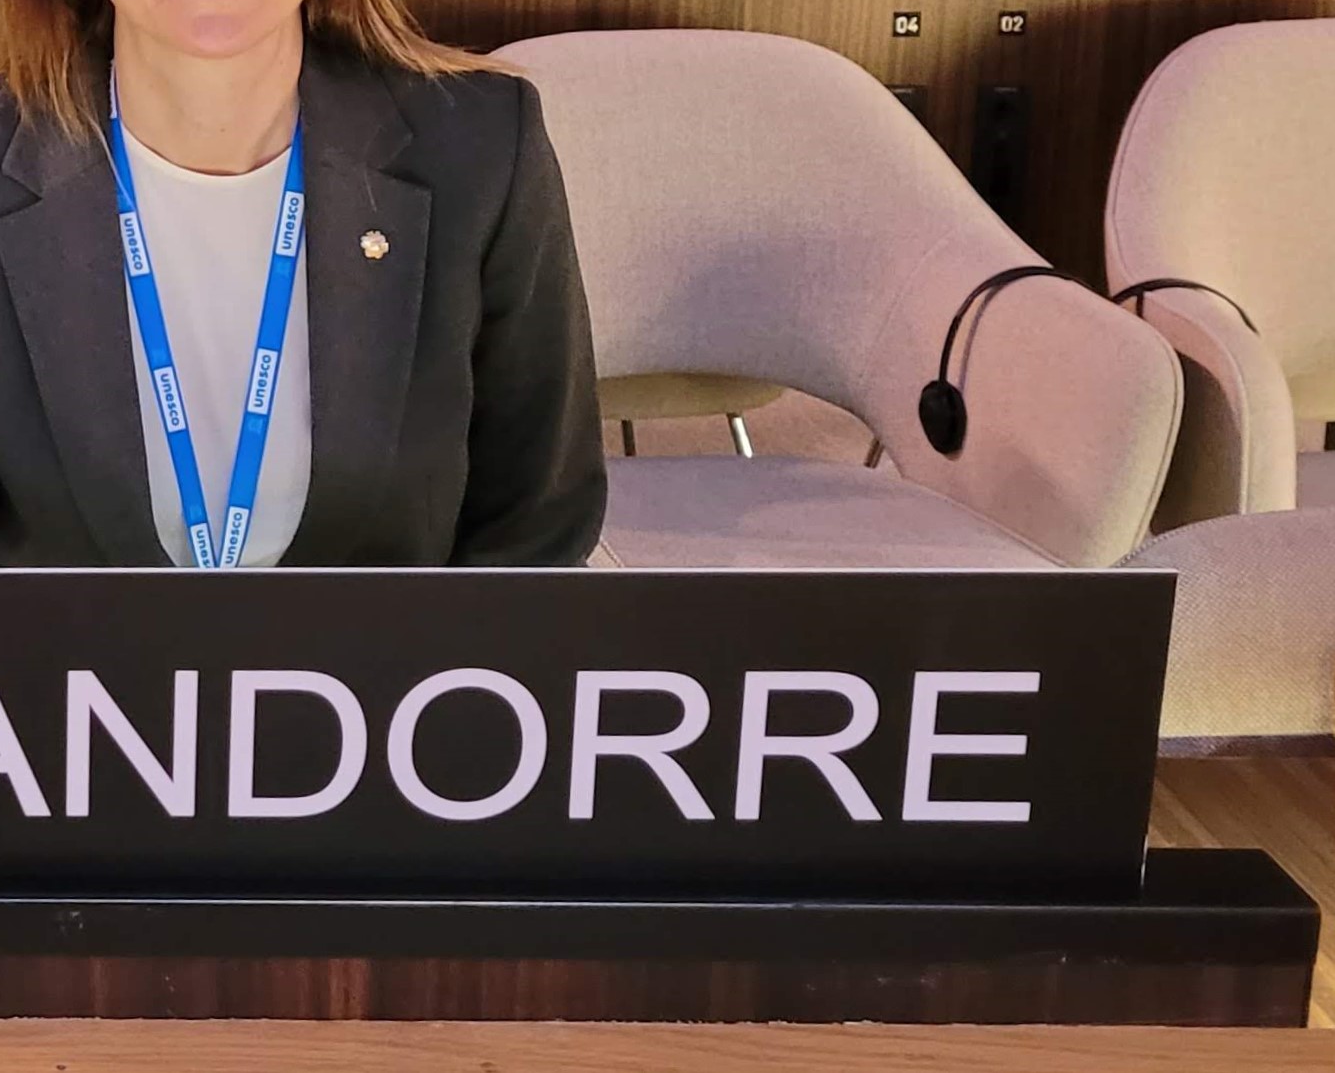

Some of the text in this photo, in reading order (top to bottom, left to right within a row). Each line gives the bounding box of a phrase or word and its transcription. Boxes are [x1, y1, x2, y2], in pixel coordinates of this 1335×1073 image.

[895, 15, 919, 35] 04
[1000, 15, 1025, 33] 02
[124, 217, 144, 271] unesco
[282, 196, 300, 251] unesco
[160, 373, 180, 427] unesco
[254, 353, 272, 408] unesco
[224, 511, 243, 564] unesco
